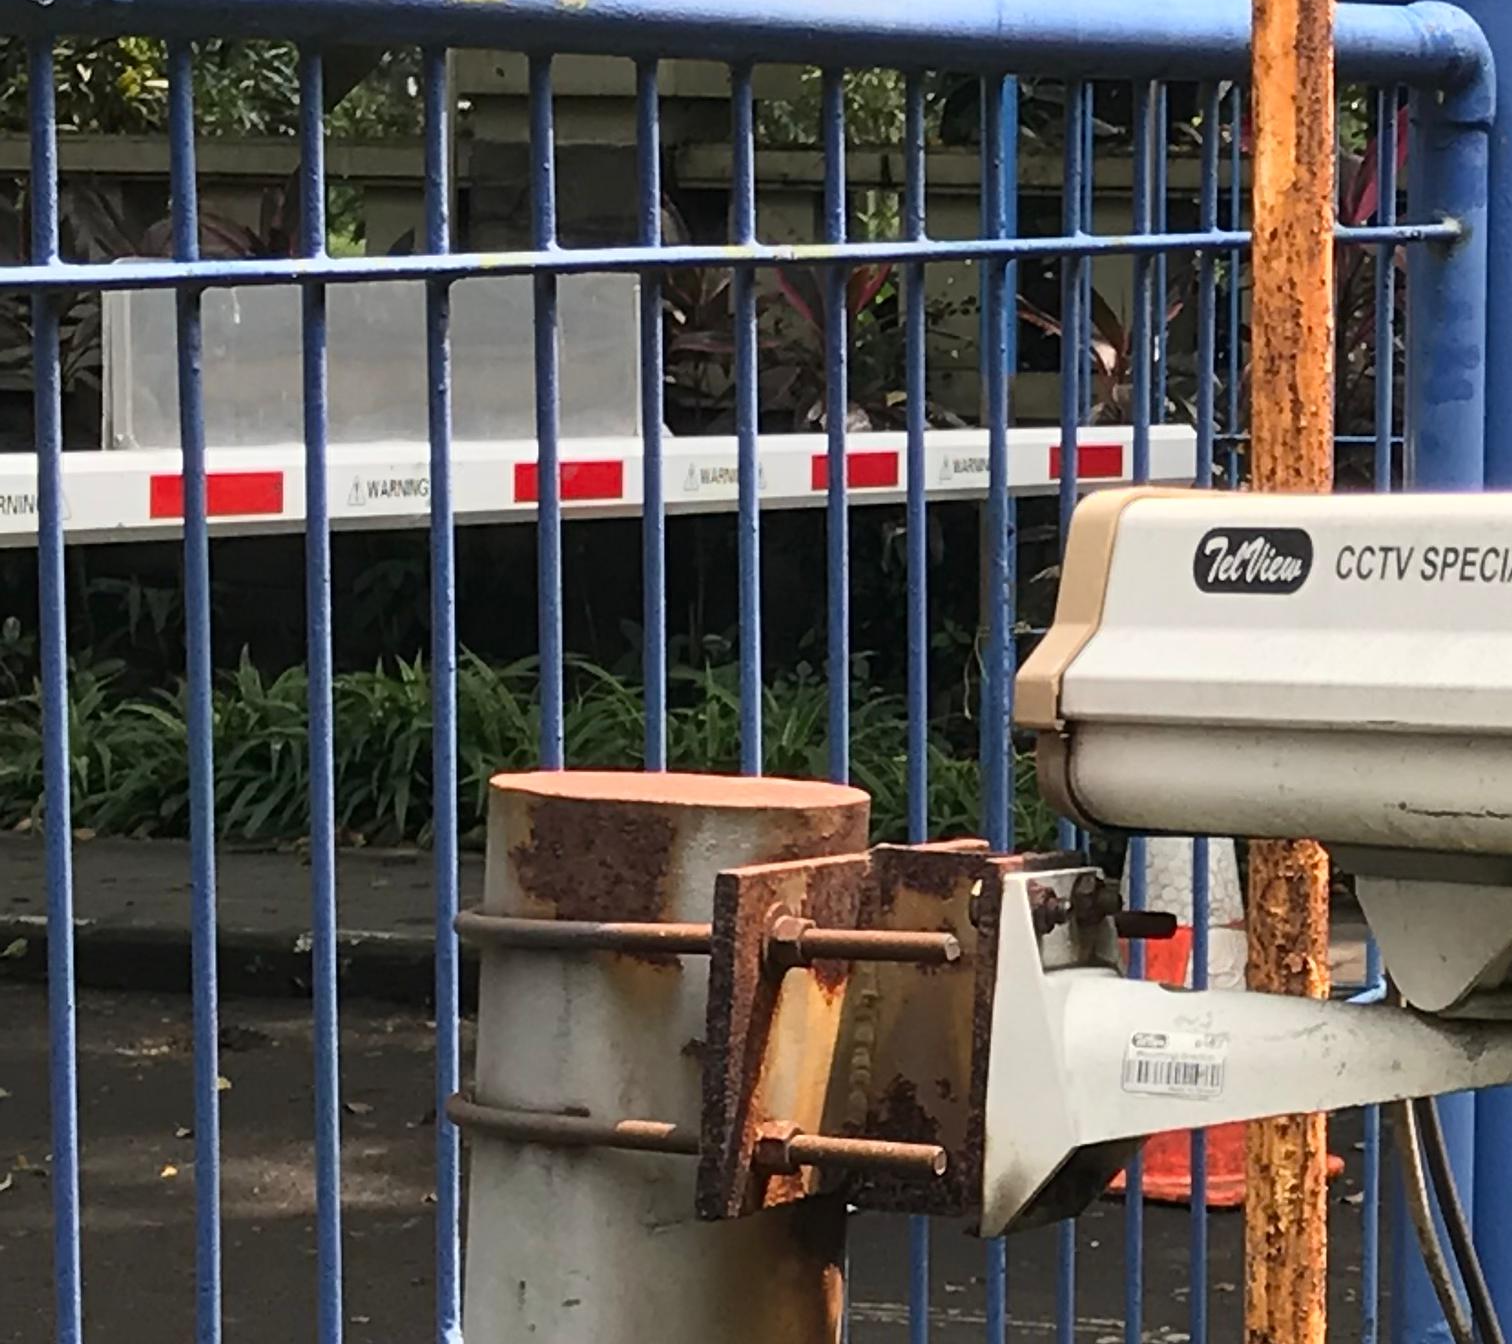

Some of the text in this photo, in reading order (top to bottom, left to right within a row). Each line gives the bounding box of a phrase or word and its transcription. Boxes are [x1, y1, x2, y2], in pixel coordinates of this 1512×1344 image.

[366, 478, 429, 498] WARNING
[1202, 535, 1304, 584] TelView
[1335, 545, 1415, 581] CCTV
